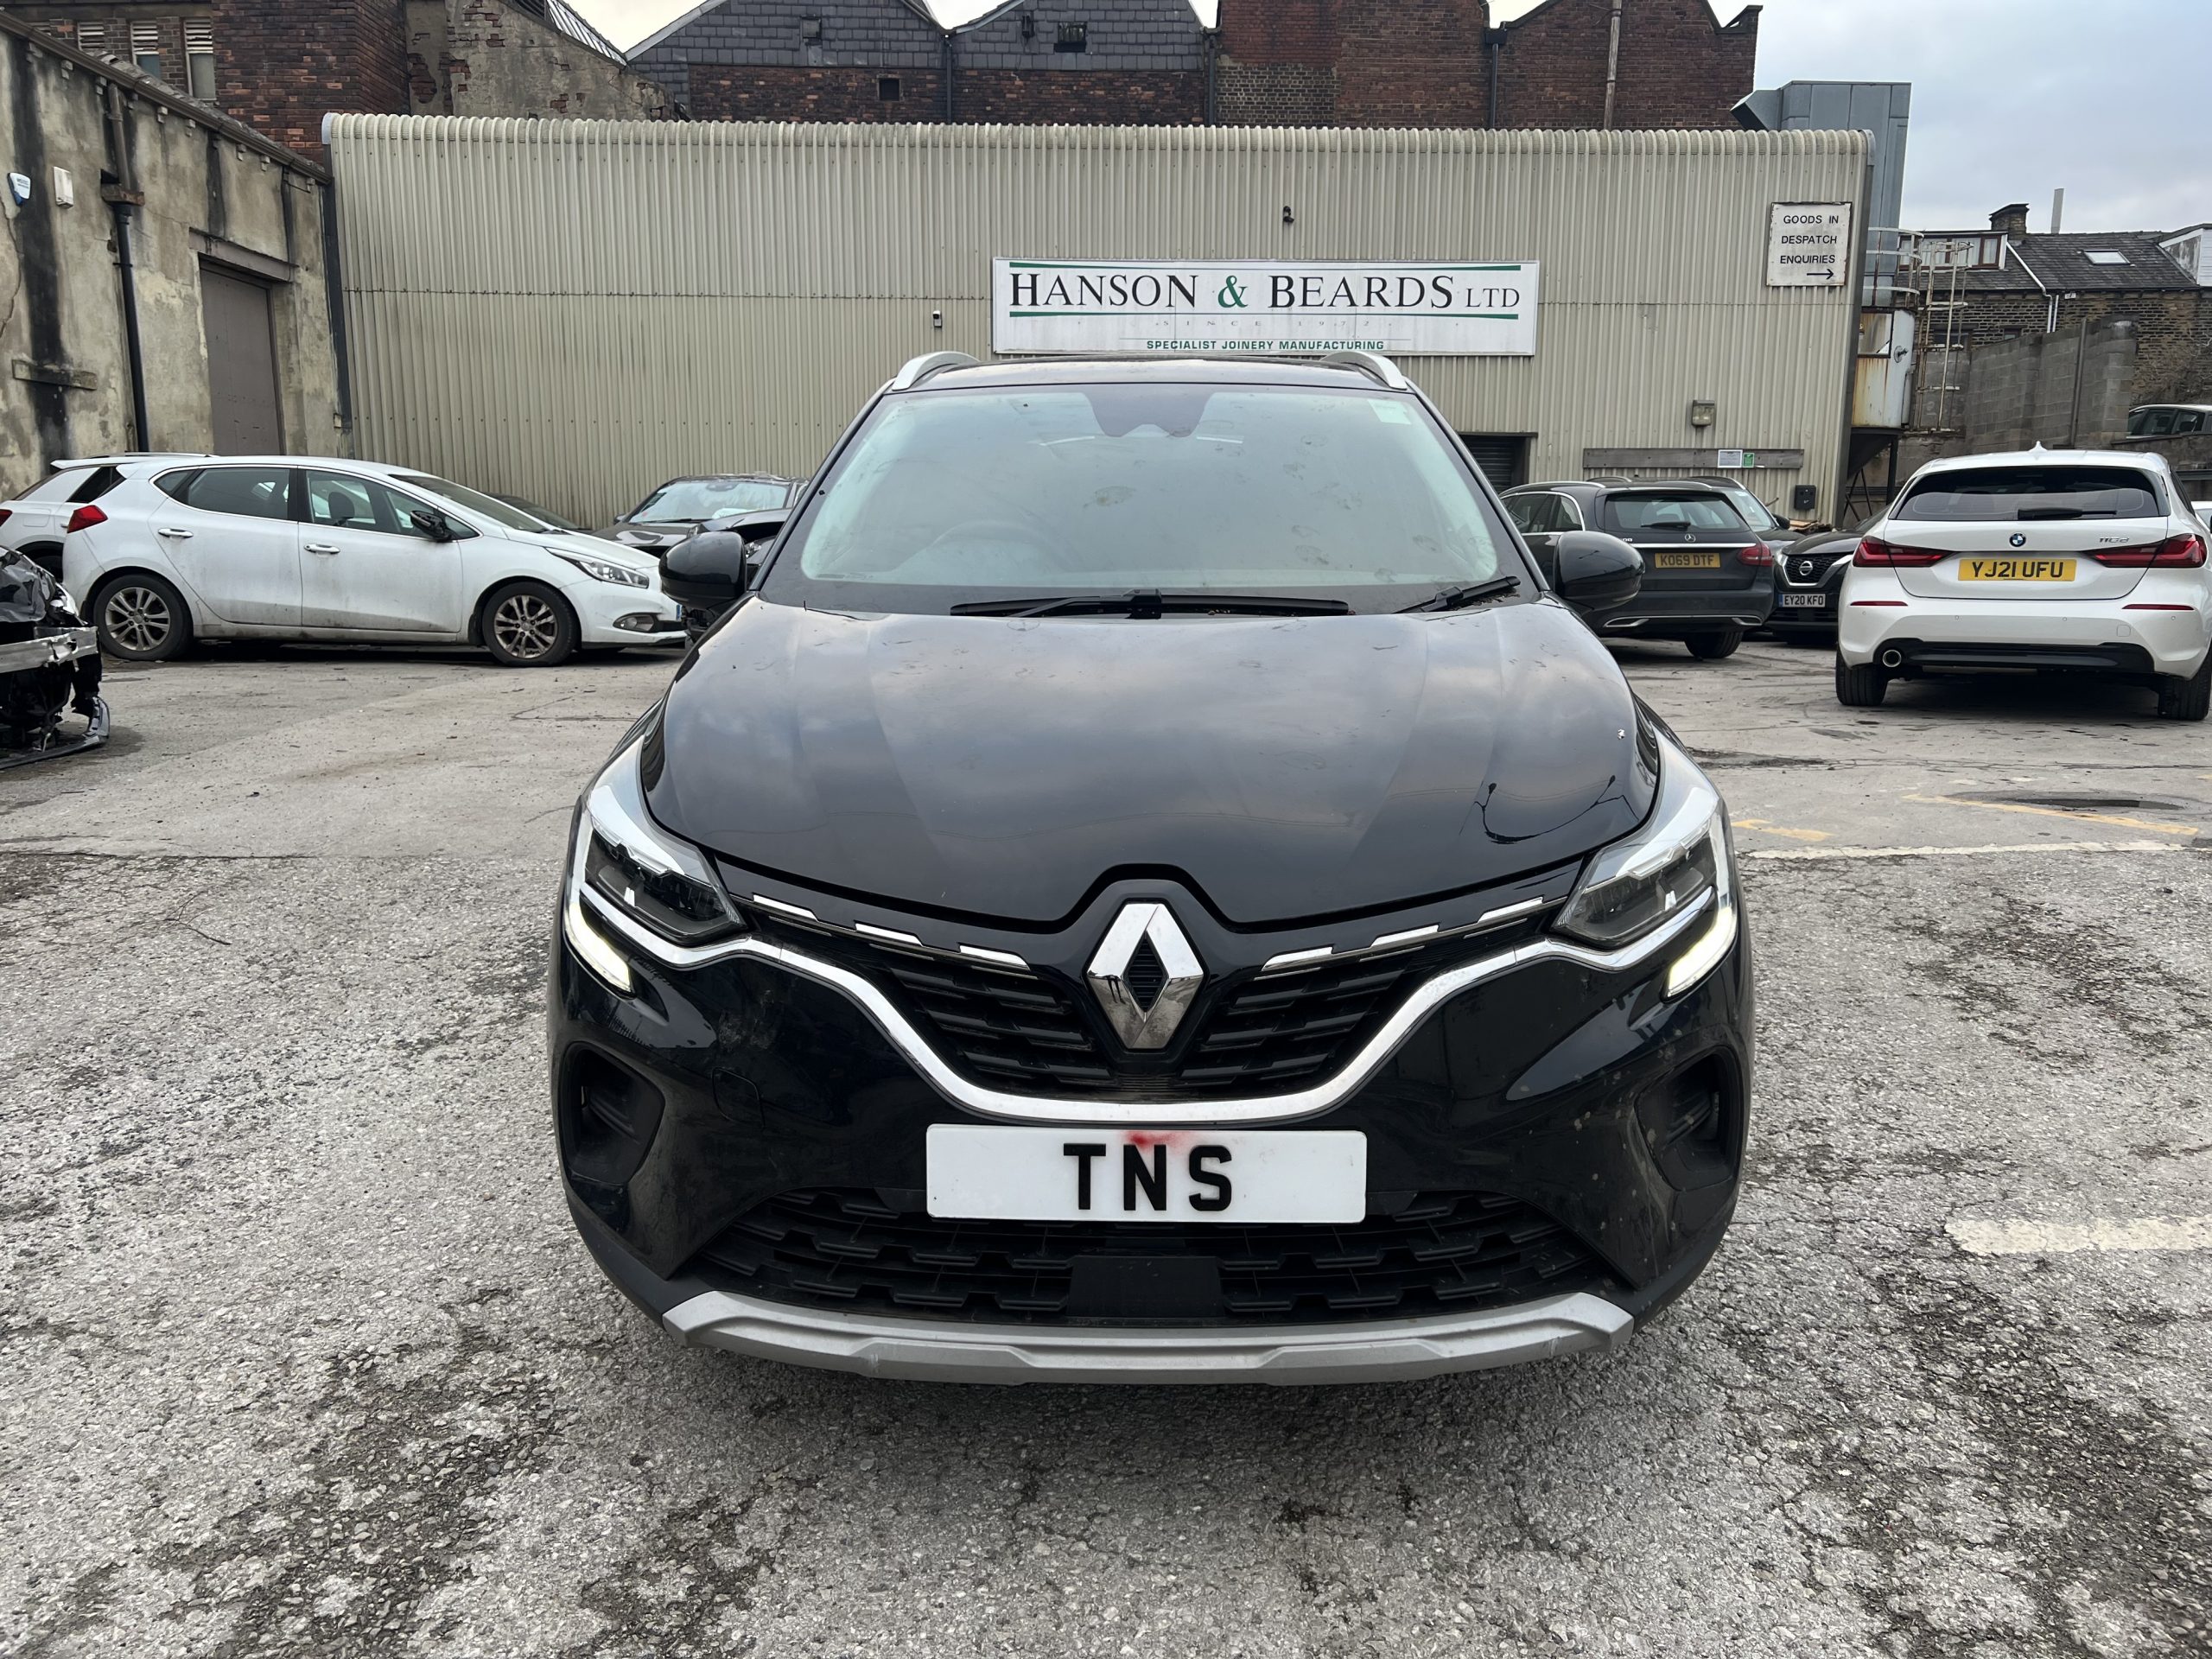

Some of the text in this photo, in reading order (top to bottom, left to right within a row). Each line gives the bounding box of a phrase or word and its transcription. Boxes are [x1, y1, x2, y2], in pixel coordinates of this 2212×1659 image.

[1783, 214, 1839, 225] GOODS IN
[1781, 235, 1838, 245] DESPATCH
[1780, 254, 1835, 264] ENQUIRIES
[1009, 273, 1520, 308] HANSON & BEARDS LTD
[1147, 340, 1384, 350] SPECIALIST JOINERY MANUFACTURING
[1694, 555, 1714, 566] DTF
[1972, 561, 2063, 578] YJ21 UFU
[1784, 595, 1823, 606] EY20 KFO
[1063, 1143, 1232, 1211] TNS
